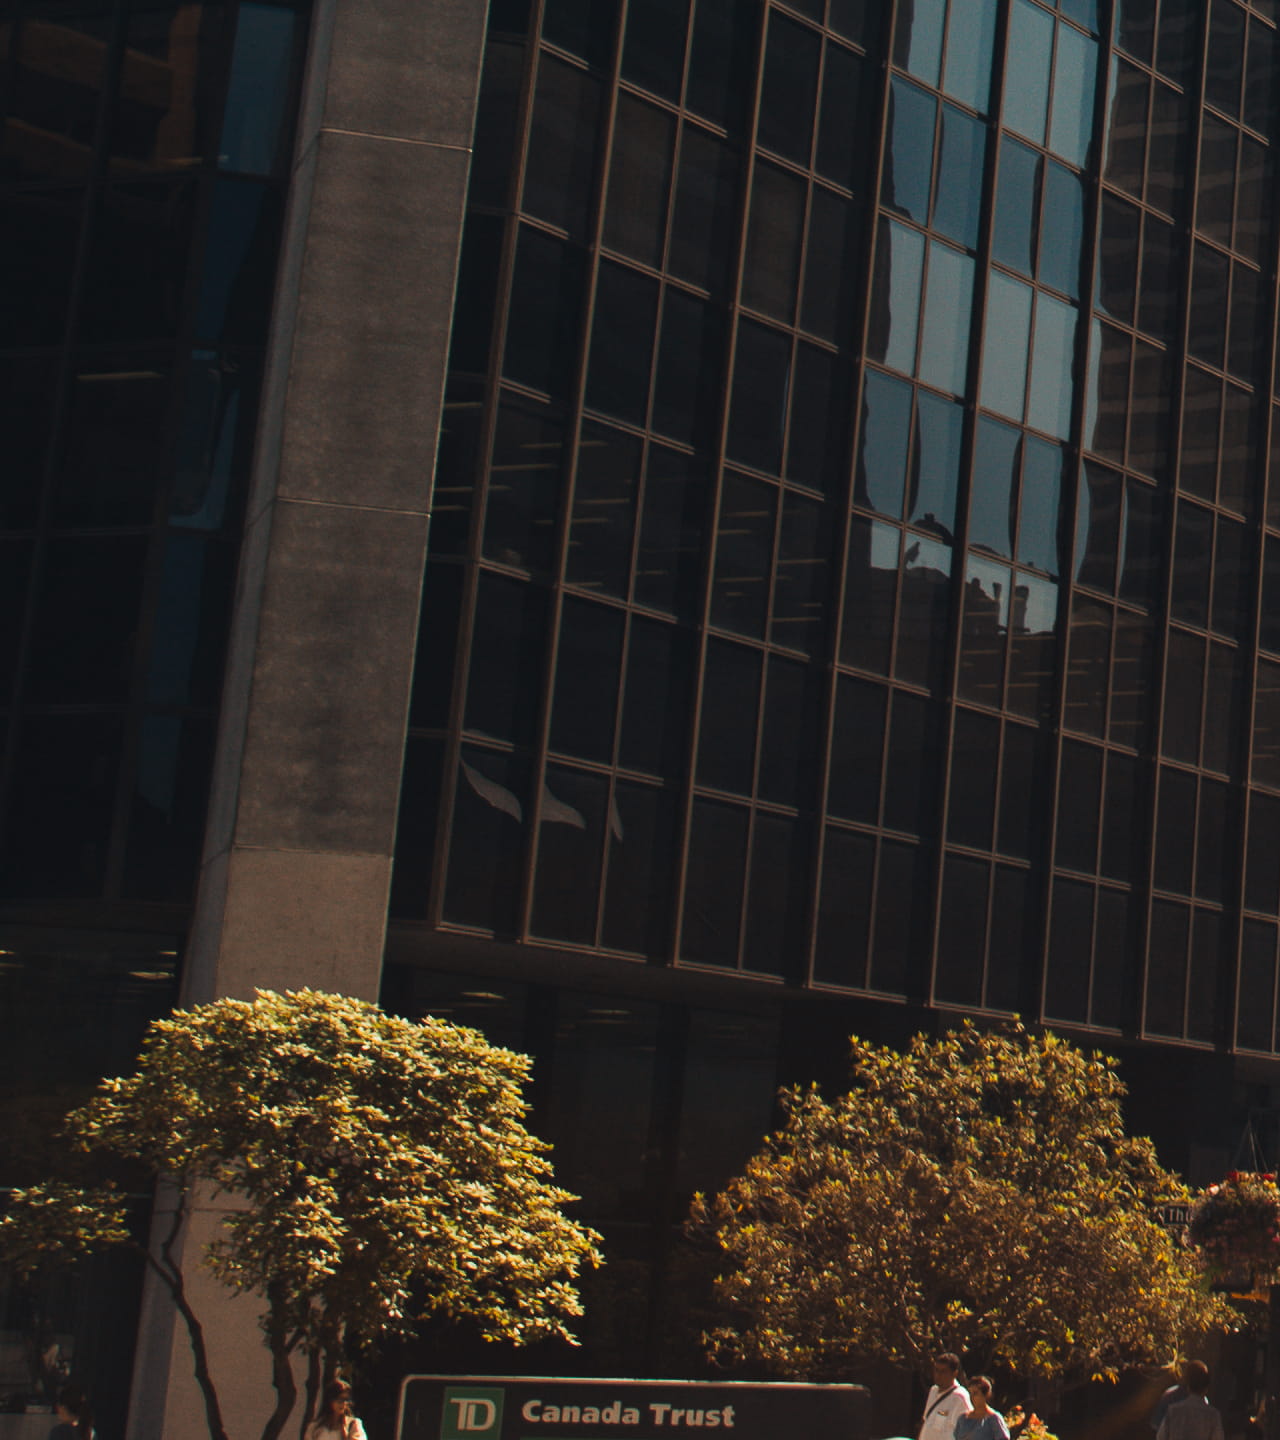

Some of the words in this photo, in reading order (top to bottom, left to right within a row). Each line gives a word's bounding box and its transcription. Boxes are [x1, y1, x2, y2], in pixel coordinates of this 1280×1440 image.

[451, 1398, 496, 1431] TD
[522, 1399, 640, 1424] Canada
[650, 1404, 735, 1427] Trust
